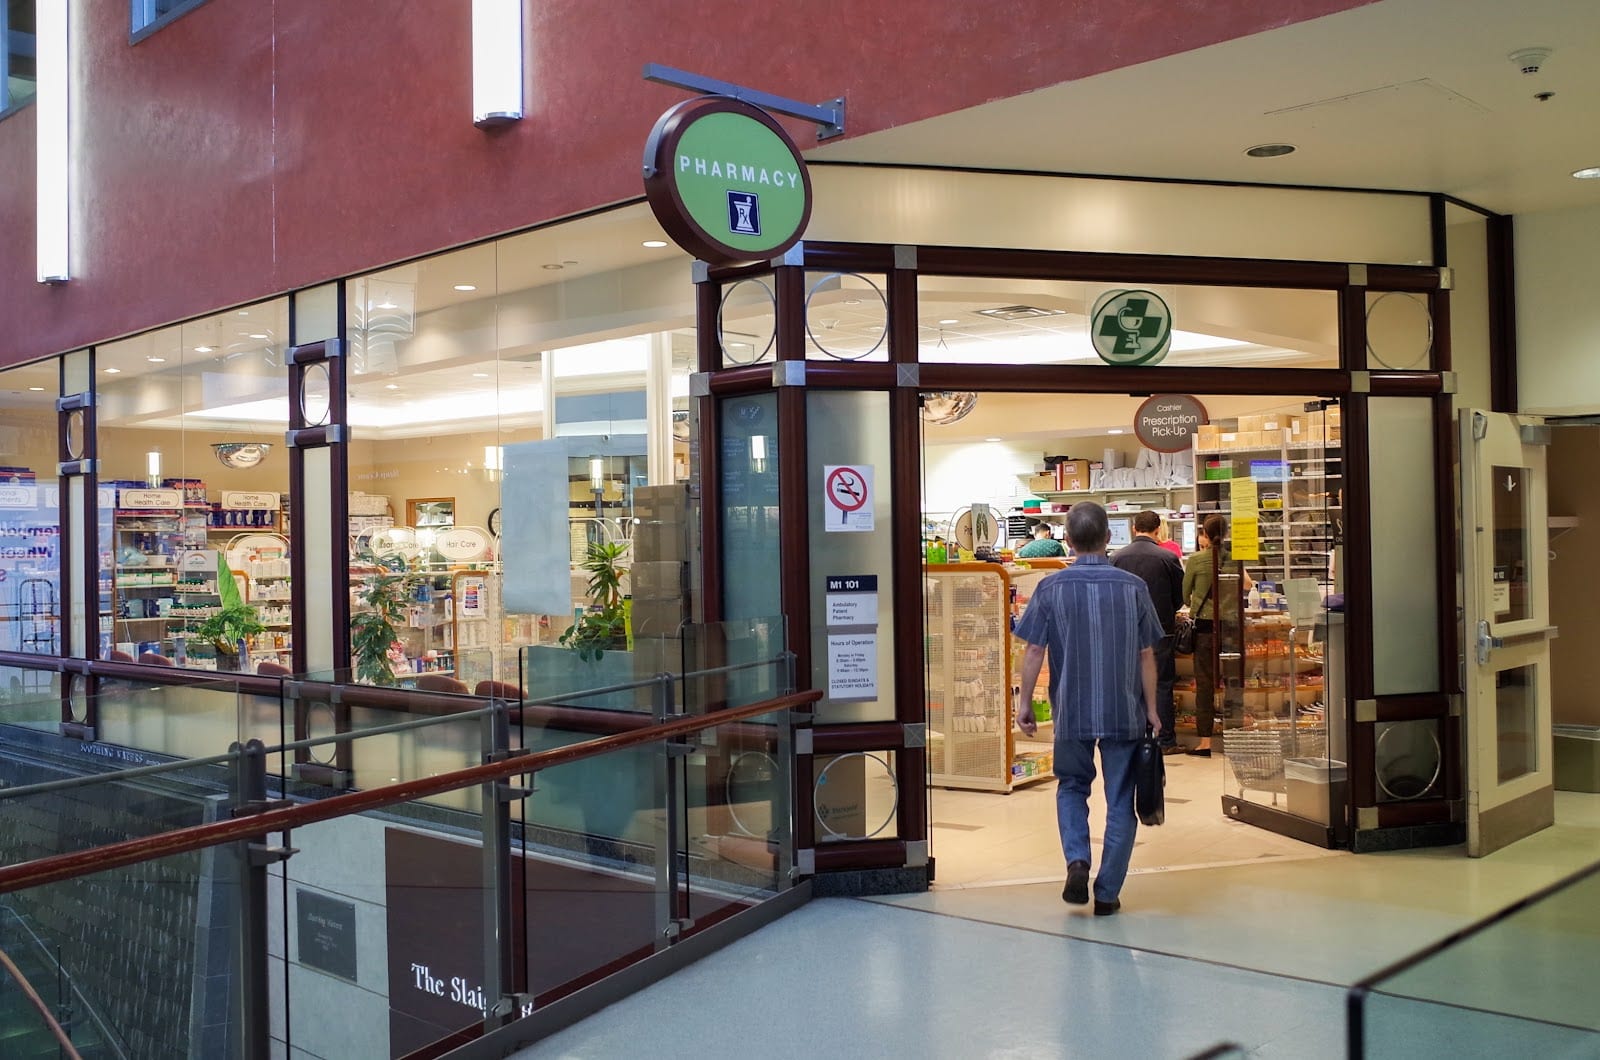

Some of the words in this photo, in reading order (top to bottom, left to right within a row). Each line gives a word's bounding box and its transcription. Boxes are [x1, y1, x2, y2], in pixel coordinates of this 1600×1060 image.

[679, 155, 798, 189] PHARMACY
[1156, 404, 1182, 412] Cashier
[1143, 415, 1197, 427] Prescription
[1152, 426, 1187, 437] Pick-Up
[830, 580, 842, 589] M1
[845, 580, 859, 589] 101
[410, 962, 445, 997] The
